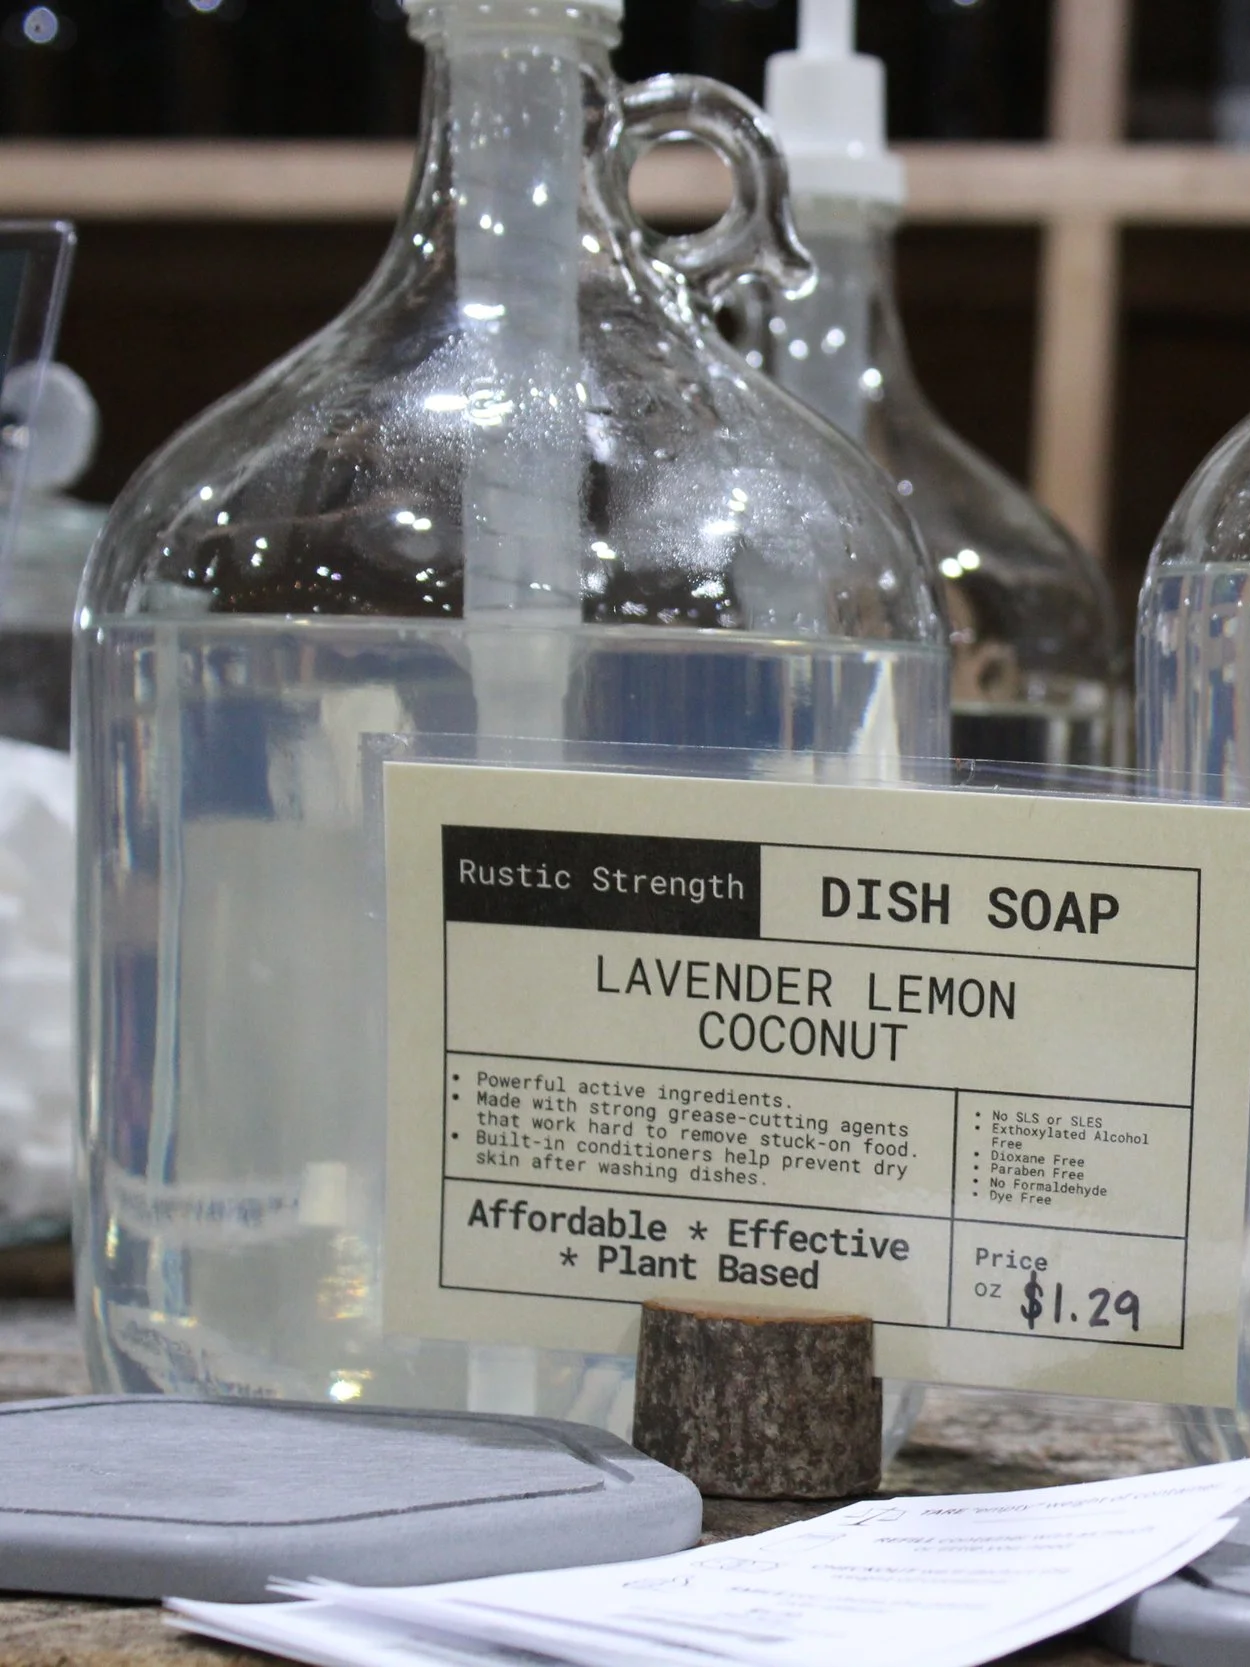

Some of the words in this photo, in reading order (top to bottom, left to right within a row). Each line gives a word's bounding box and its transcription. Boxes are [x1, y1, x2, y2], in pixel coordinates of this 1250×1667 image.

[460, 858, 571, 890] Rustic
[592, 866, 744, 904] Strength
[821, 876, 950, 925] DISH
[987, 886, 1120, 935] SOAP
[597, 954, 832, 1008] LAVENDER
[868, 972, 1015, 1020] LEMON
[698, 1010, 908, 1062] COCONUT
[477, 1071, 566, 1093] Powerful
[578, 1081, 646, 1099] active
[658, 1084, 791, 1109] ingredients.
[477, 1090, 521, 1109] Made
[532, 1096, 577, 1113] with
[589, 1101, 656, 1123] strong
[668, 1108, 828, 1135] grease-cutting
[840, 1120, 909, 1138] agents
[477, 1110, 520, 1129] that
[532, 1116, 576, 1132] work
[588, 1117, 633, 1137] hard
[646, 1124, 667, 1140] to
[681, 1128, 748, 1145] remove
[760, 1132, 850, 1153] stuck-on
[863, 1138, 917, 1158] food.
[992, 1110, 1008, 1122] No
[1016, 1111, 1040, 1125] SLS
[1046, 1116, 1062, 1126] or
[1070, 1115, 1103, 1129] SLES
[992, 1122, 1086, 1141] Exthoxylated
[1094, 1130, 1149, 1145] Alcohol
[476, 1129, 565, 1155] Built-in
[576, 1140, 713, 1163] conditioners
[724, 1147, 770, 1170] help
[782, 1155, 861, 1174] prevent
[874, 1159, 908, 1181] dry
[991, 1136, 1023, 1150] Free
[991, 1149, 1045, 1165] Dioxane
[1053, 1154, 1085, 1168] Free
[476, 1149, 520, 1167] skin
[531, 1153, 586, 1172] after
[598, 1160, 678, 1183] washing
[690, 1165, 766, 1185] dishes.
[990, 1162, 1045, 1177] Paraben
[1053, 1167, 1084, 1181] Free
[990, 1177, 1006, 1189] No
[1013, 1178, 1108, 1197] Formaldehyde
[989, 1189, 1013, 1204] Dye
[1020, 1191, 1052, 1206] Free
[467, 1198, 667, 1242] Affordable
[728, 1218, 910, 1262] Effective
[598, 1244, 697, 1281] Plant
[718, 1253, 819, 1290] Based
[975, 1247, 1048, 1273] Price
[974, 1282, 1002, 1299] oz
[1020, 1270, 1140, 1333] $1.29
